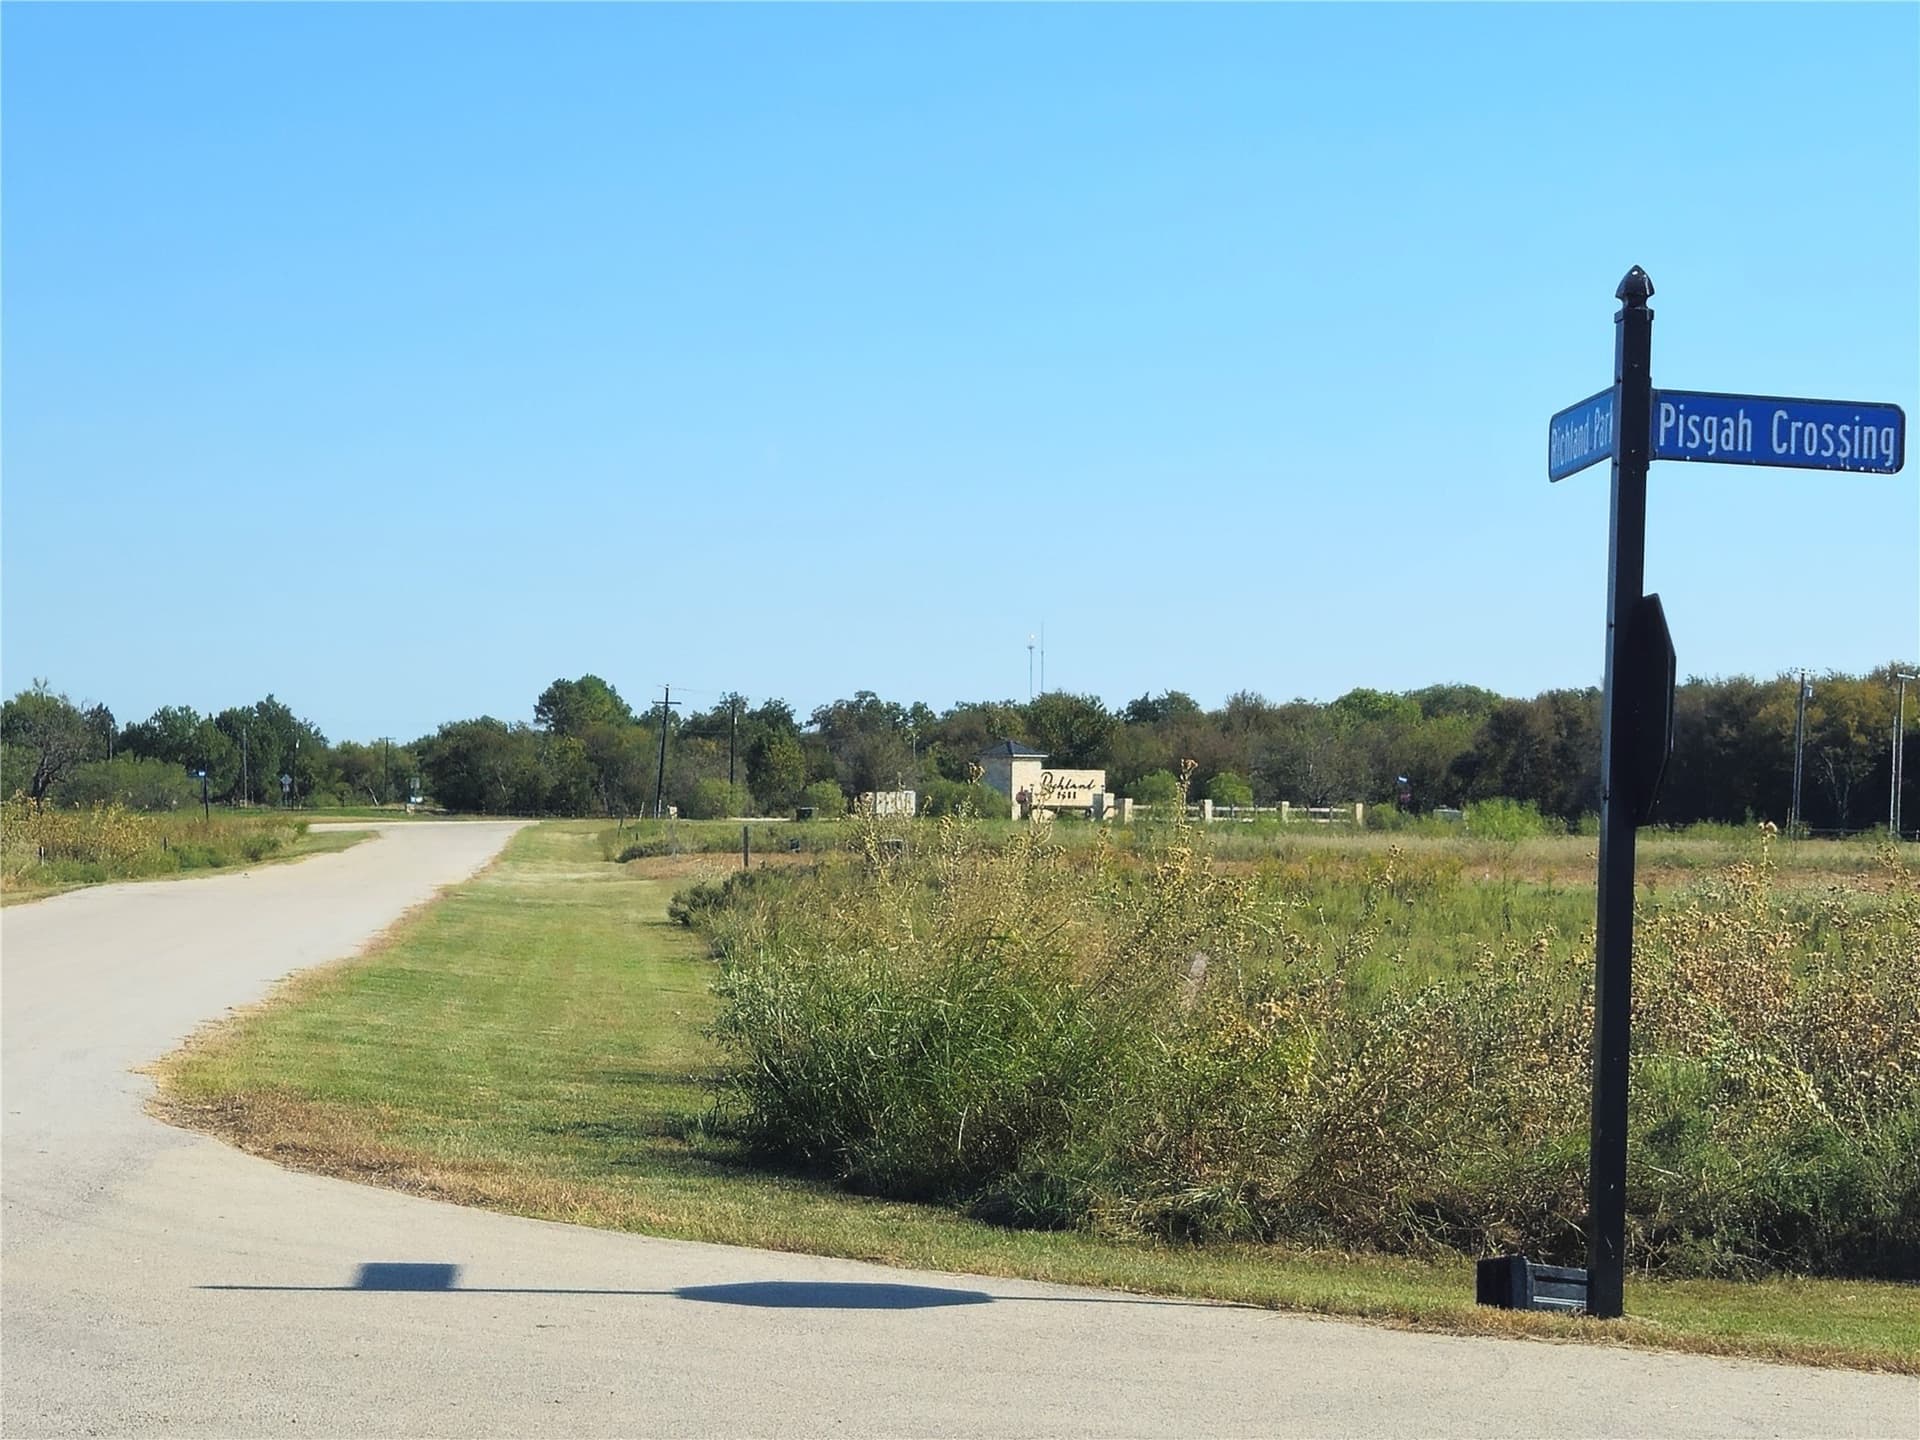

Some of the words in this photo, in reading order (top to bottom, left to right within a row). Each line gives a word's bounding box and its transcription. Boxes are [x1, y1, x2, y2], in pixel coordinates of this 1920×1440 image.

[1551, 411, 1590, 470] Richland
[1658, 402, 1752, 456] Pisgah
[1772, 409, 1896, 467] Crossing
[1041, 771, 1096, 793] Rchland
